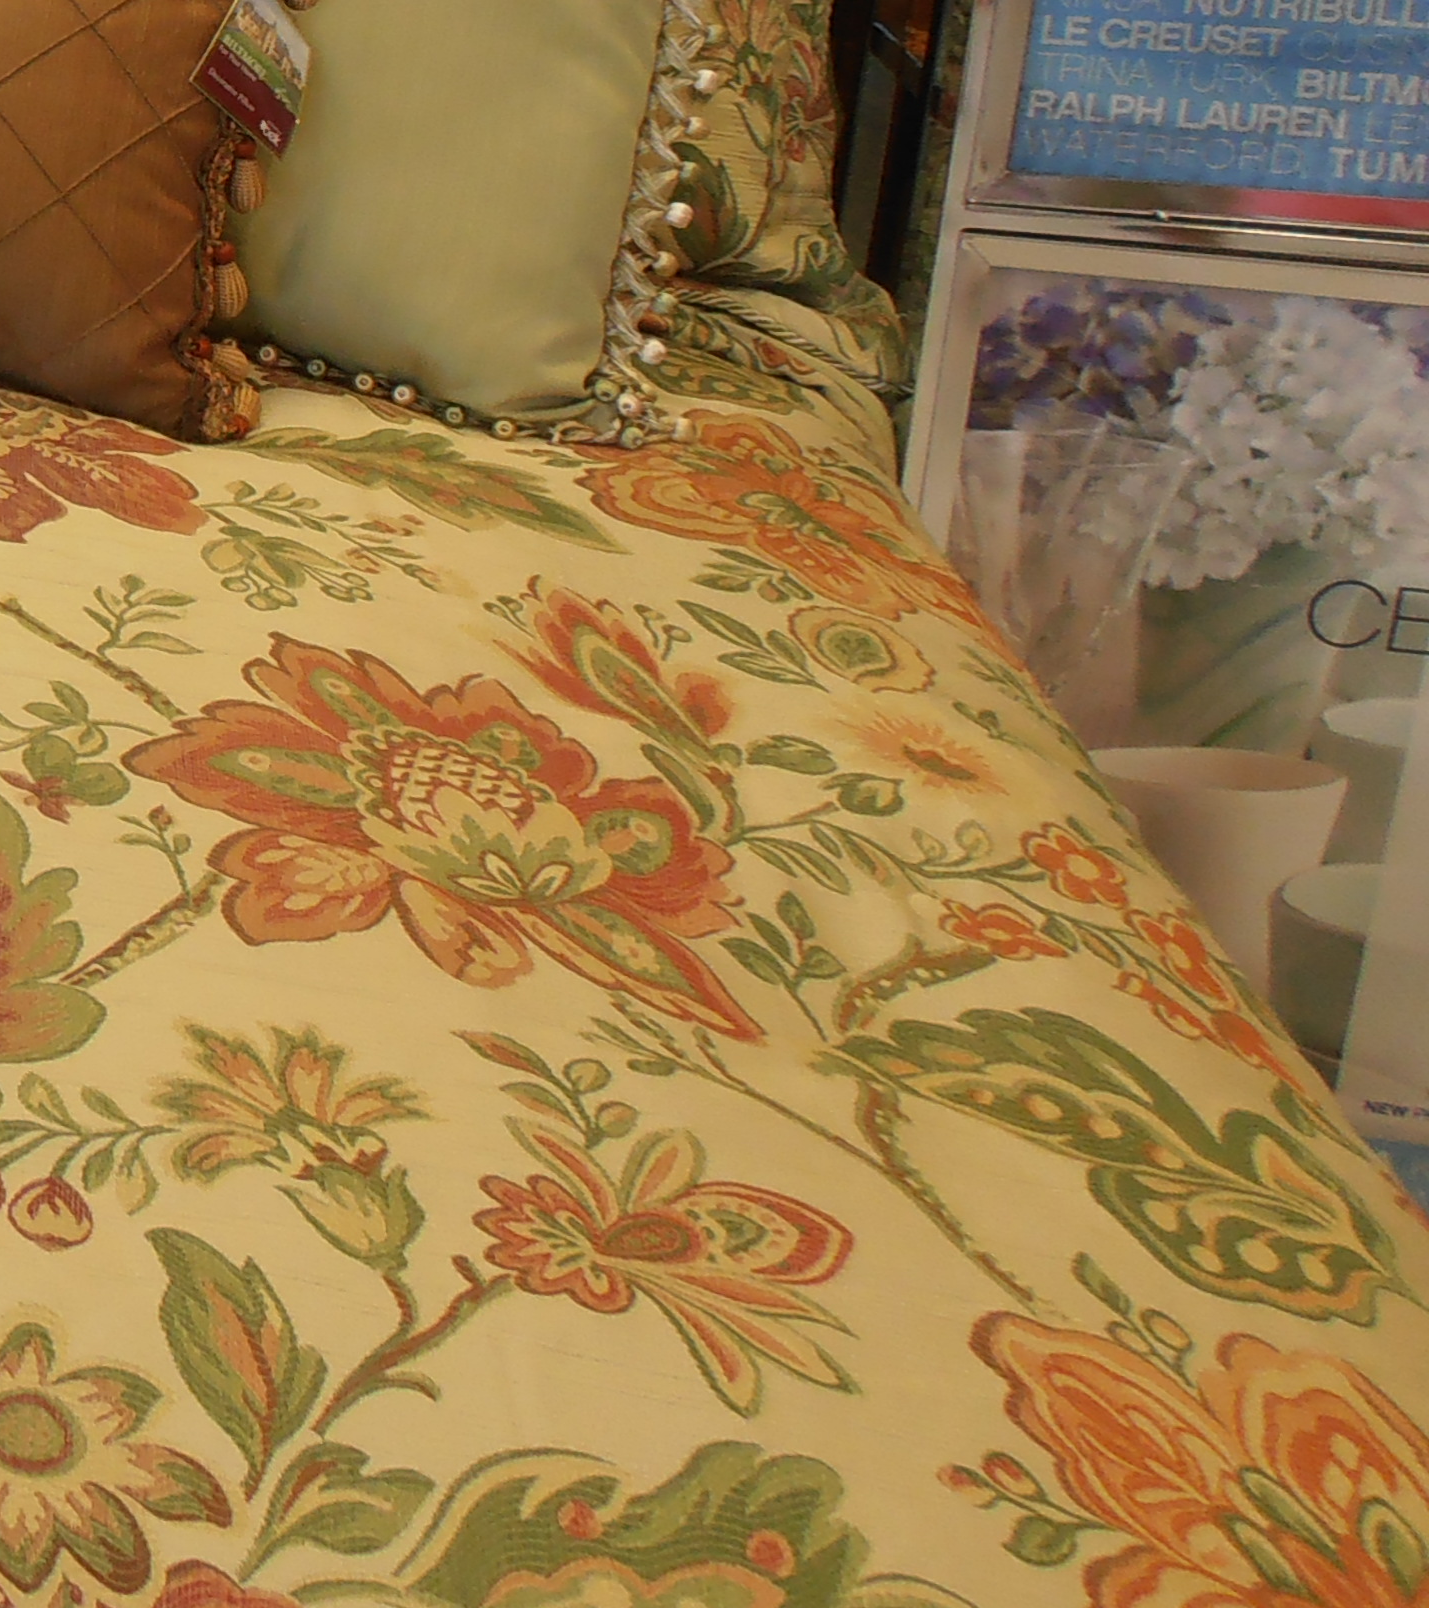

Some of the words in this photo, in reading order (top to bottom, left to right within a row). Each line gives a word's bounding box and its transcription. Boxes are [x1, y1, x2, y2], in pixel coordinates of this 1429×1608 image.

[1041, 14, 1093, 47] LE
[1098, 17, 1290, 58] CREUSET
[1295, 67, 1429, 106] BILTM
[1027, 89, 1167, 127] RALPH
[1175, 97, 1349, 141] LAUREN
[1363, 108, 1429, 146] LE
